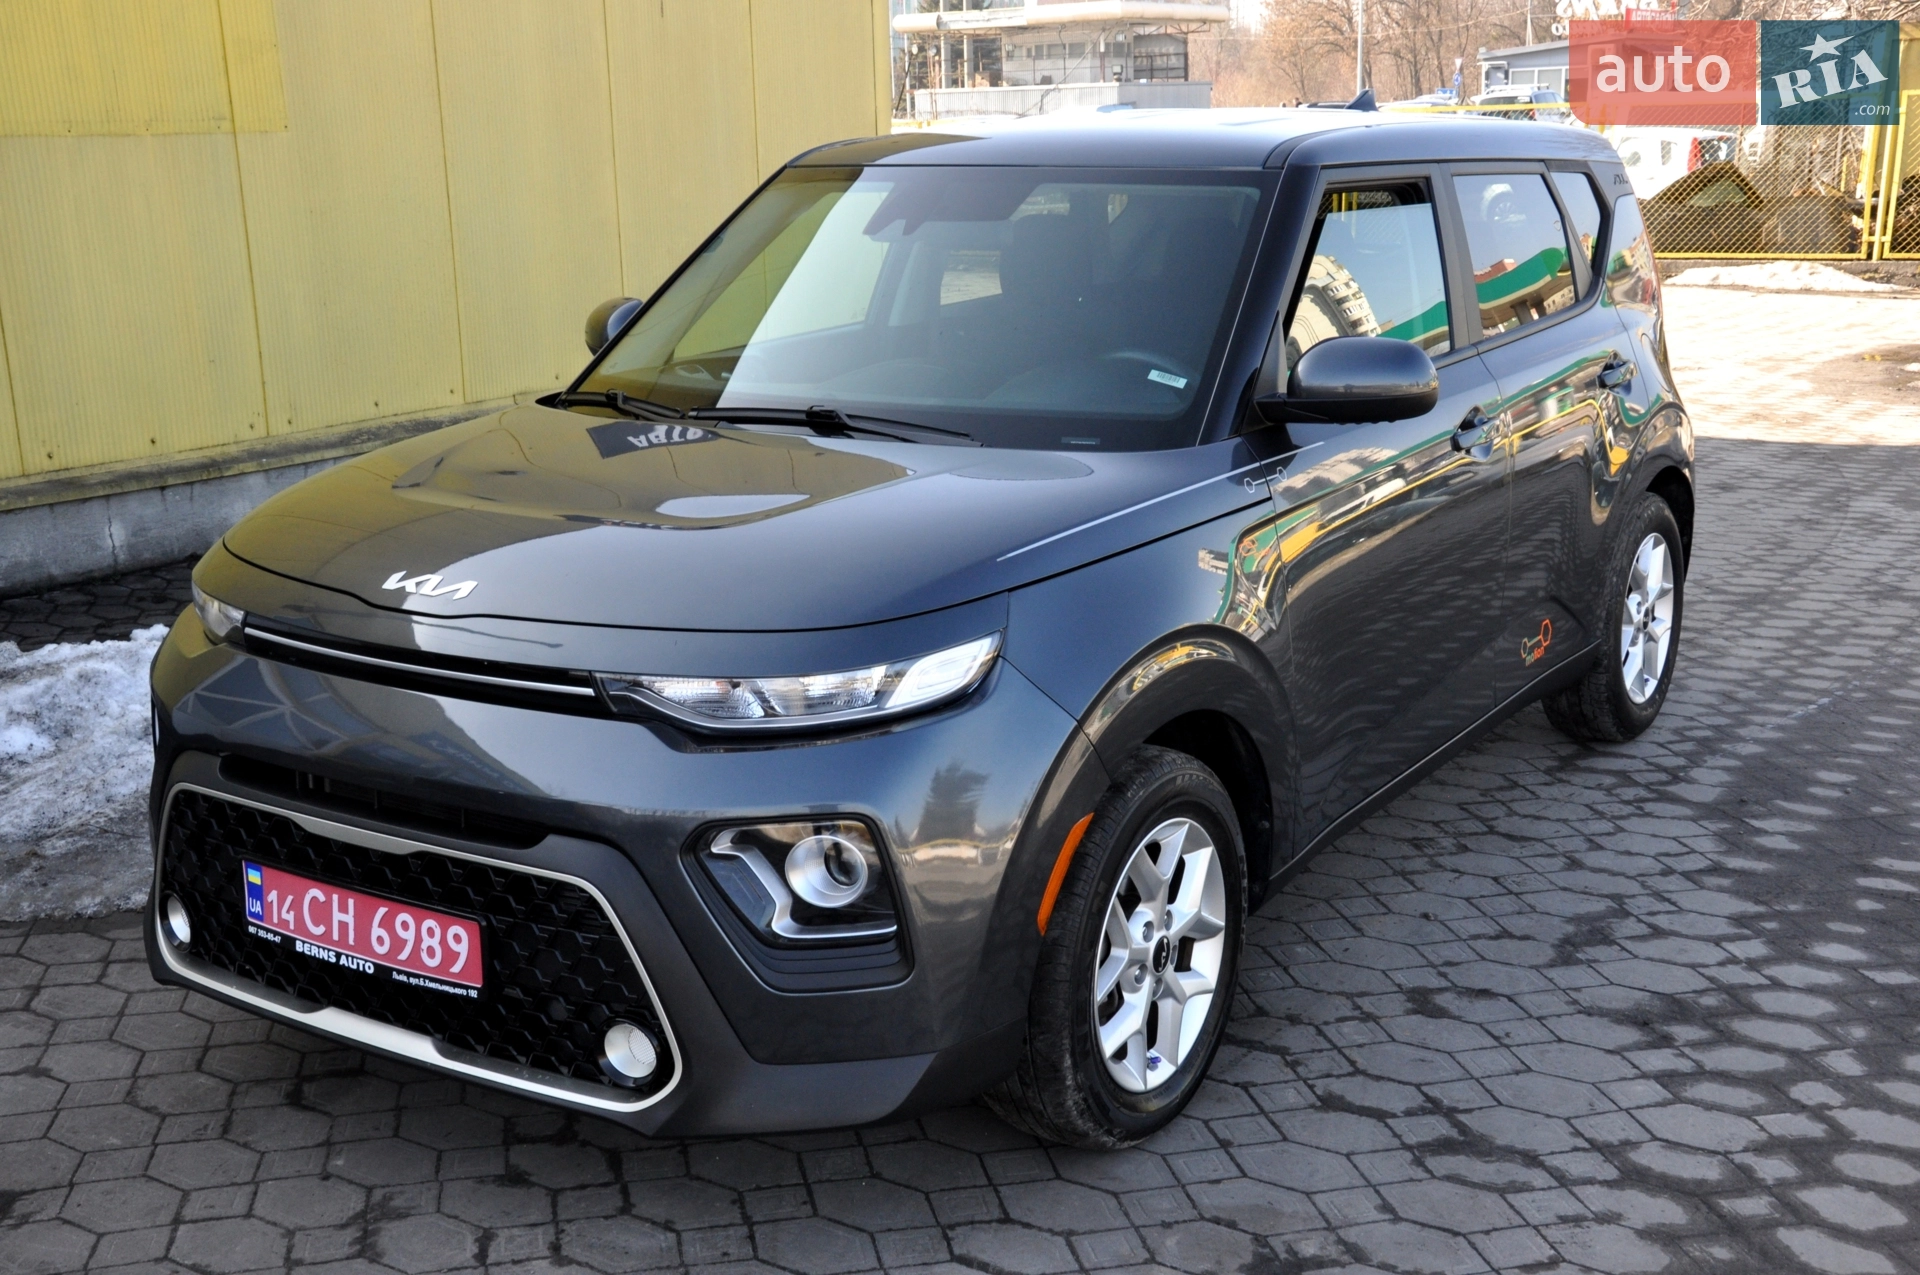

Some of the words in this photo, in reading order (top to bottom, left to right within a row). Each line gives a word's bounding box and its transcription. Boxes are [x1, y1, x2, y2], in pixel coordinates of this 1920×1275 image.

[249, 897, 262, 915] UA
[370, 906, 469, 974] 6989
[295, 939, 337, 963] BERNS
[339, 954, 375, 974] AUTO
[467, 988, 478, 998] 192
